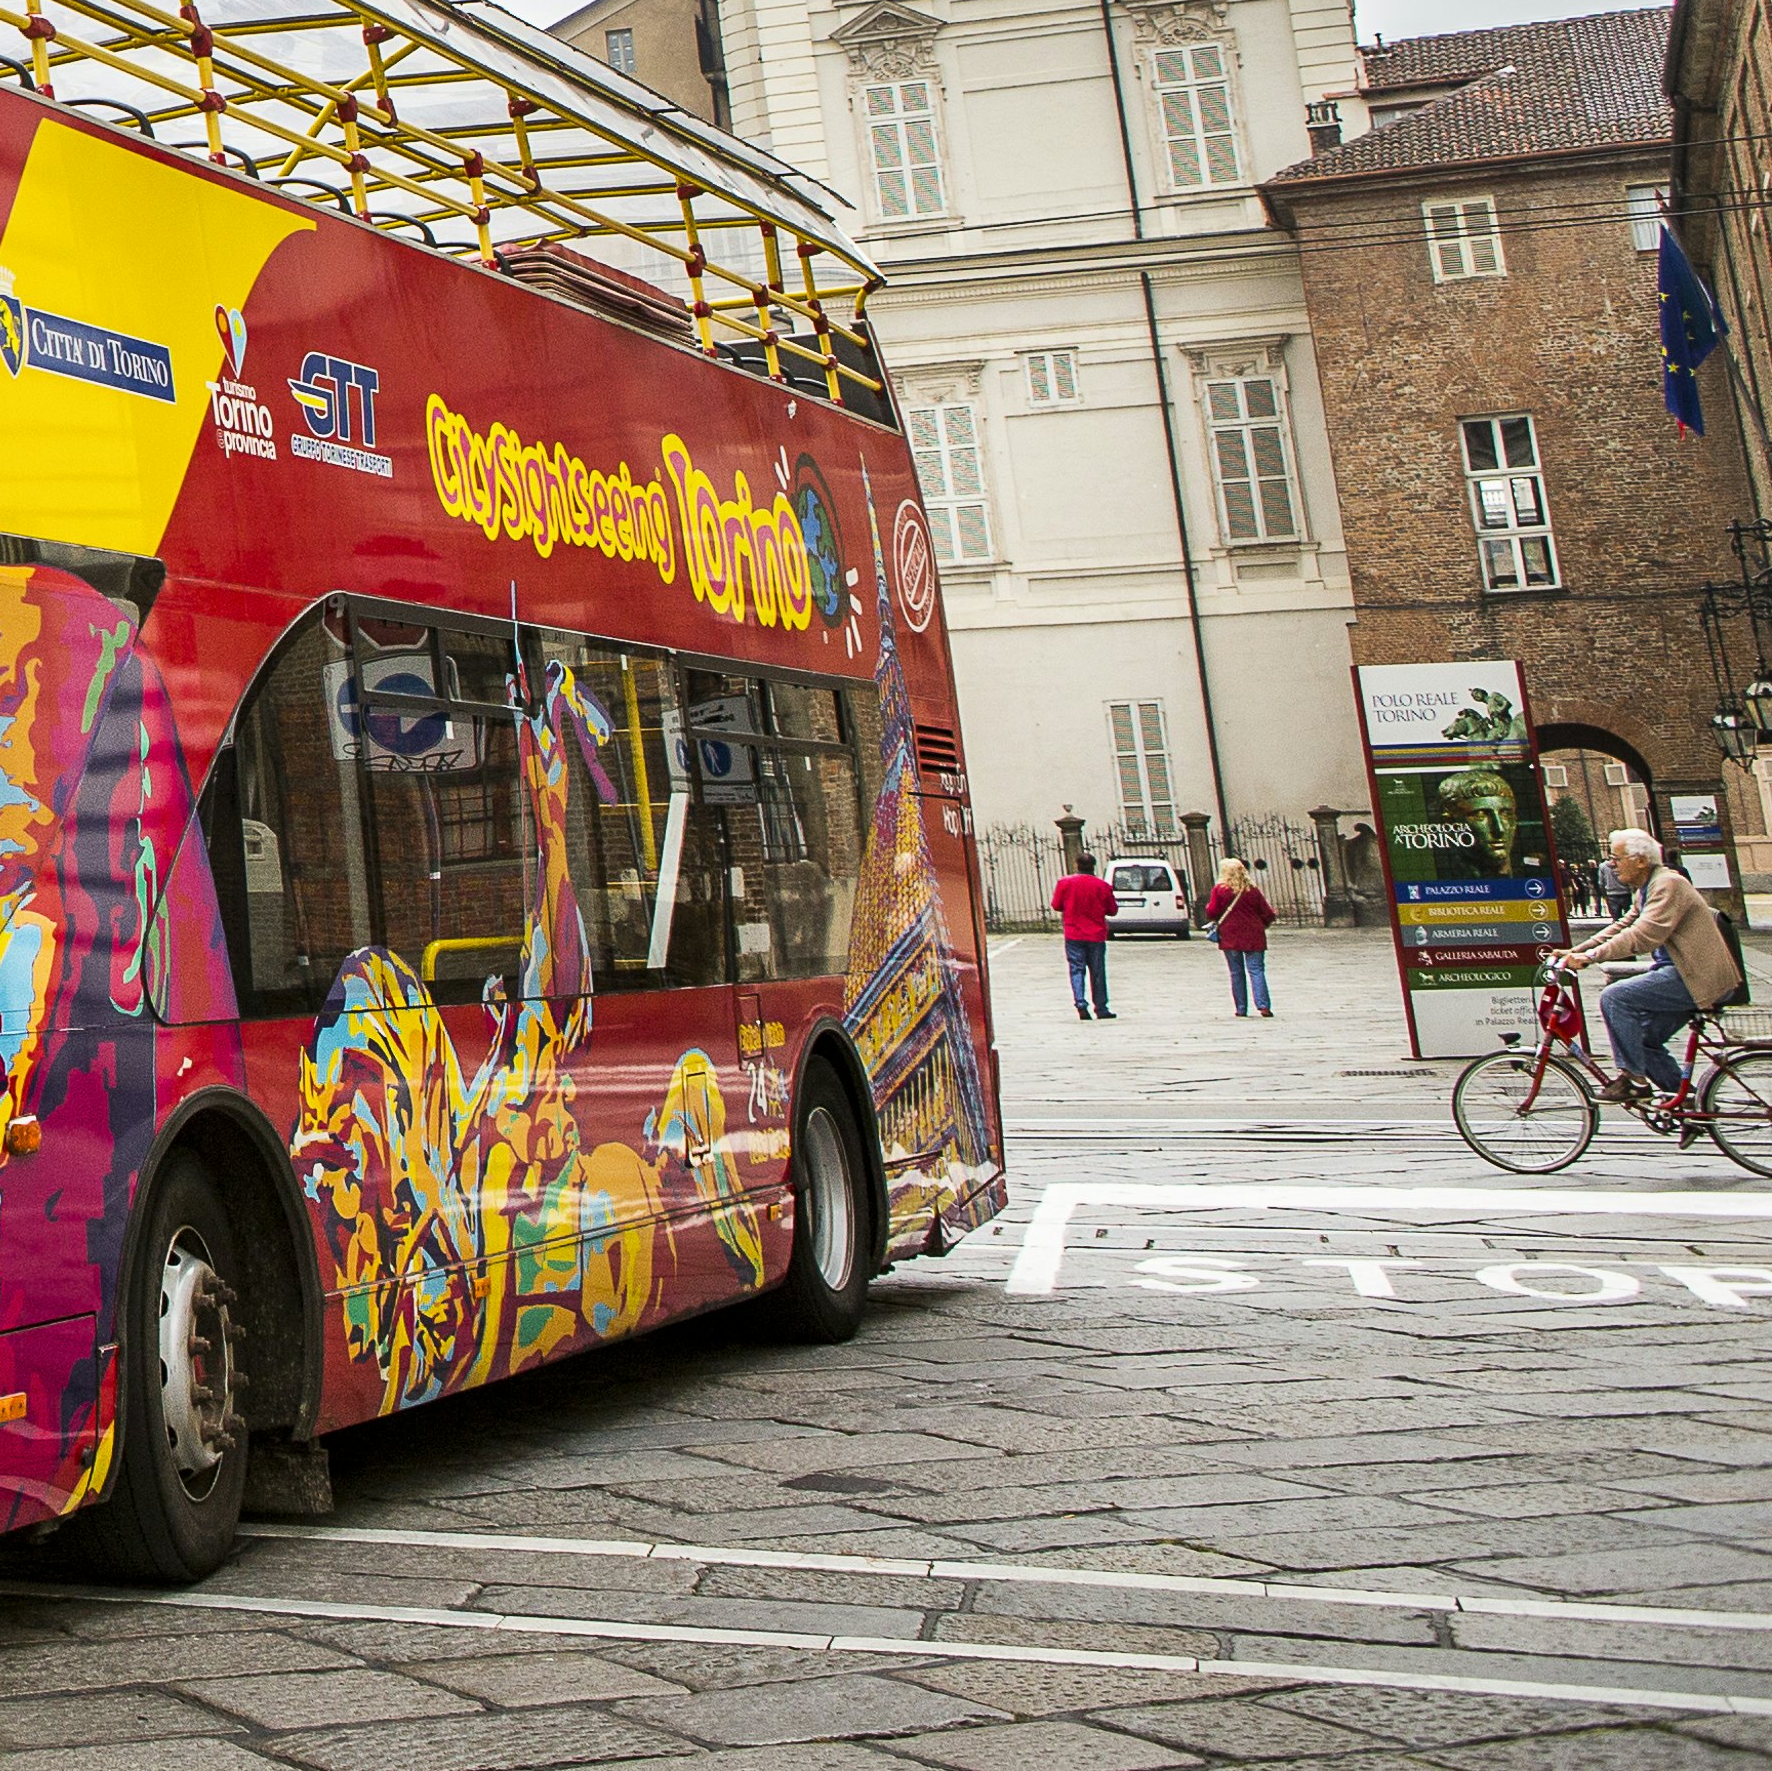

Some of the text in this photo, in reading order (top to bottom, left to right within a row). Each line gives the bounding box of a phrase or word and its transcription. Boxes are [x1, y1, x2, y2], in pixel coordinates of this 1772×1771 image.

[222, 377, 257, 401] turismo
[287, 351, 379, 449] GTT
[205, 380, 273, 439] Torino
[224, 430, 277, 461] provincia
[292, 435, 320, 459] GRUPPO
[321, 442, 355, 468] TORINESE
[425, 392, 813, 632] CitySightseeing Torino
[1372, 691, 1459, 708] POLO REALE
[1374, 708, 1437, 723] TORINO
[1392, 822, 1472, 835] ARCHEOLOGIA
[1395, 832, 1475, 849] A TORINO
[1425, 884, 1491, 895] PALAZZO REALE
[1428, 906, 1505, 917] BIBLIOTECA REALE
[1432, 928, 1499, 939] ARMERIA REALE
[1435, 949, 1519, 961] GALLERIA SABAUDA
[1439, 971, 1512, 982] ARCHEOLOGICO
[1490, 1007, 1513, 1015] ticket
[1485, 1017, 1516, 1026] Palazzo
